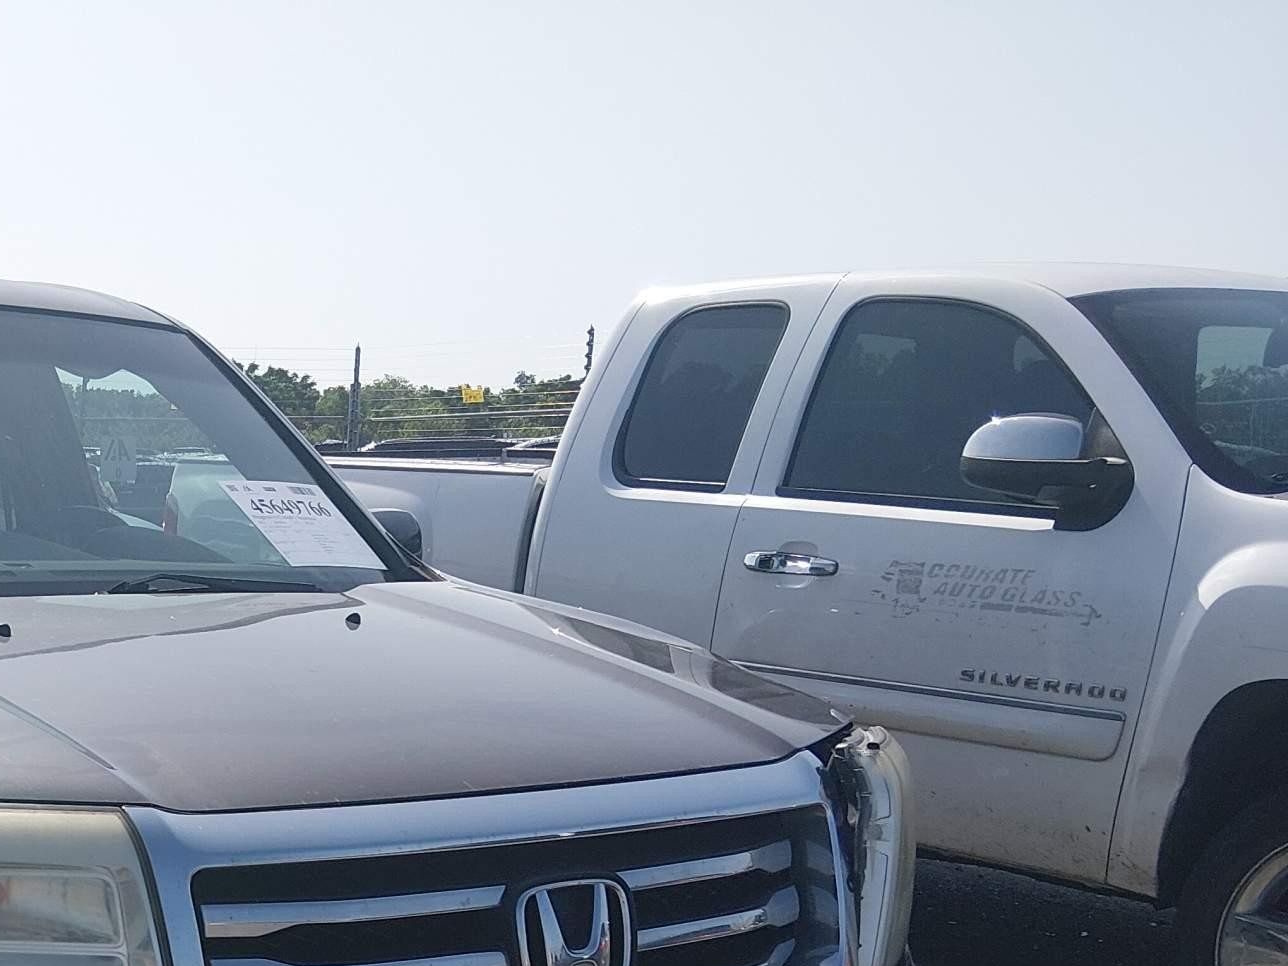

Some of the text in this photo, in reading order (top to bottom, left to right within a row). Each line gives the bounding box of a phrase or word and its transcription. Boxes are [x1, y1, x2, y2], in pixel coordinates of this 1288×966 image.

[250, 498, 332, 517] 45649766
[933, 581, 997, 600] AUTO
[1001, 585, 1083, 608] GLASS
[959, 667, 1127, 702] SILVERADO
